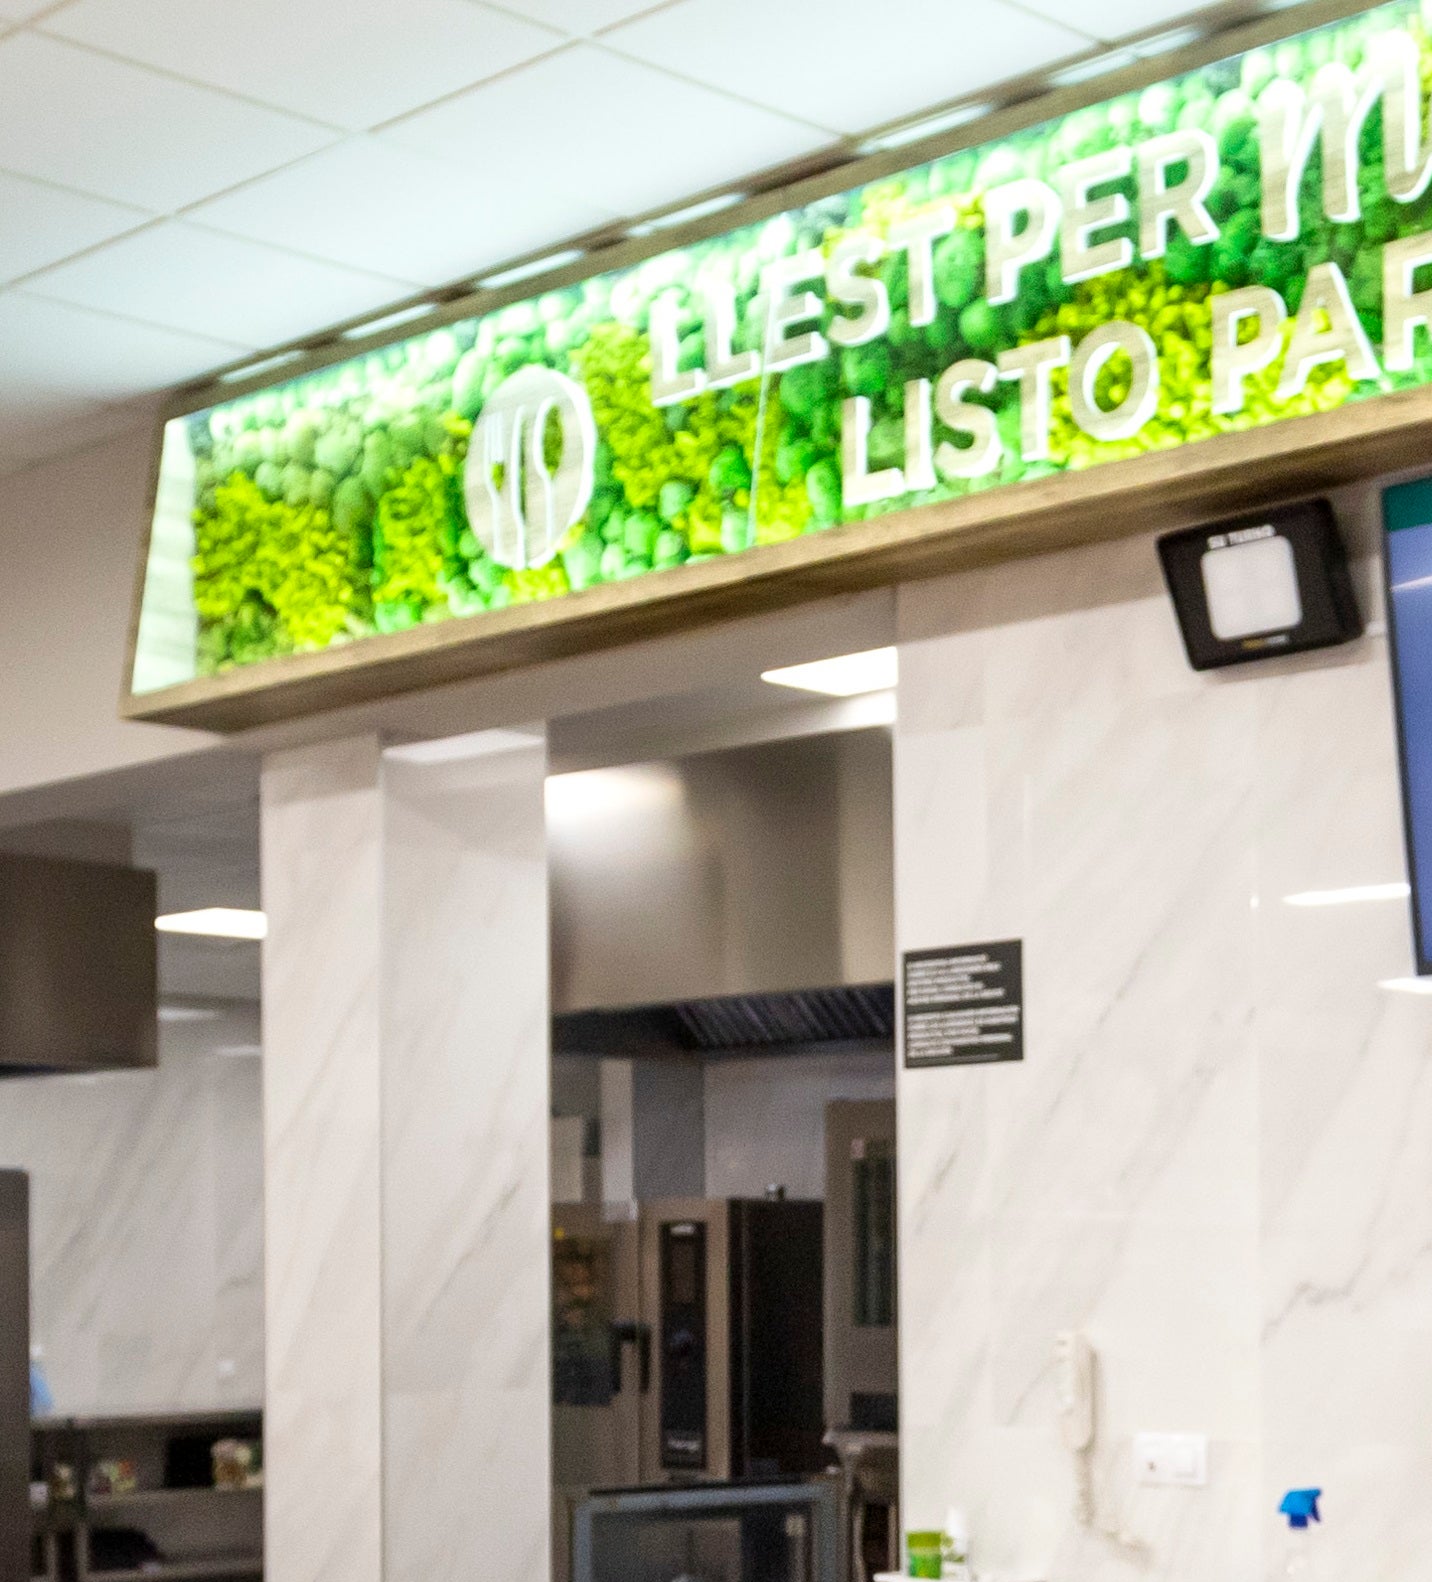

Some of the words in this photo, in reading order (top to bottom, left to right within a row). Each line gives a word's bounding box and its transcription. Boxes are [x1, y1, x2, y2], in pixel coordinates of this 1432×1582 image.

[650, 205, 956, 407] LLEST
[984, 128, 1221, 307] PER
[841, 319, 1159, 504] LISTO
